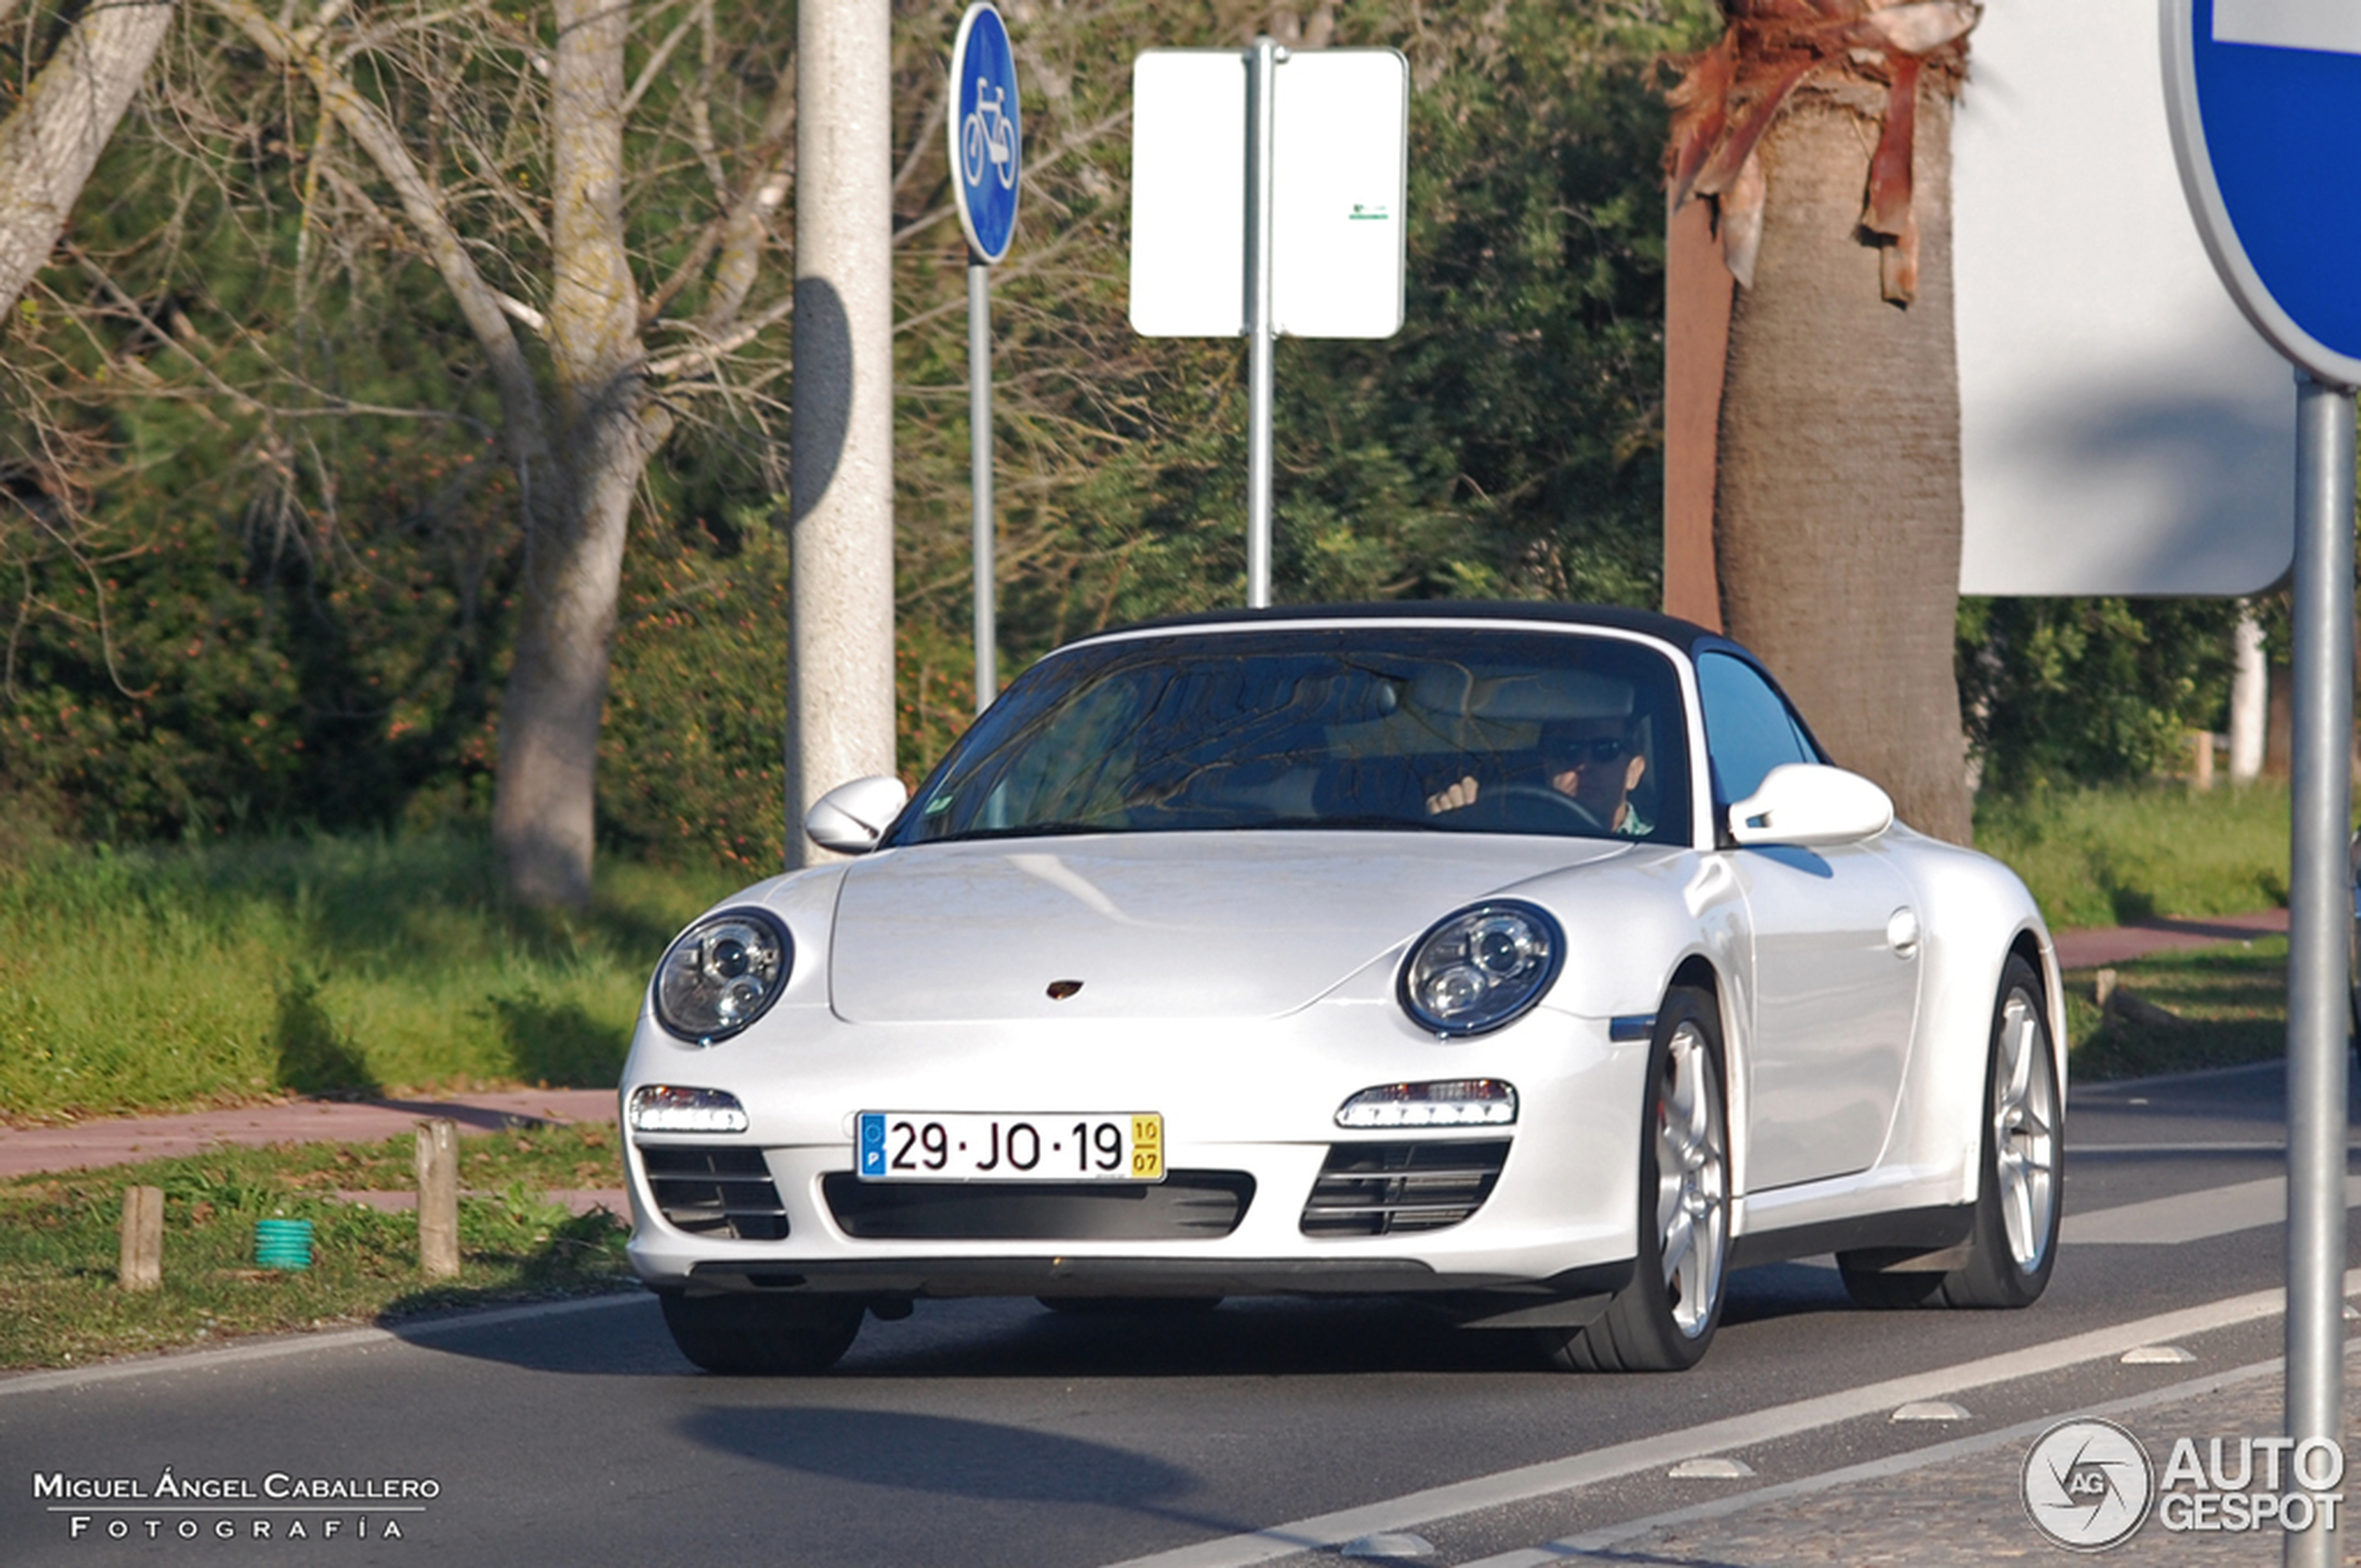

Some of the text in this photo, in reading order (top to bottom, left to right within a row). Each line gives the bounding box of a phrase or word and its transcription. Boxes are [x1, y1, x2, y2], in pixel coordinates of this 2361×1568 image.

[1136, 1122, 1157, 1140] 10
[867, 1152, 879, 1166] P
[1133, 1153, 1157, 1171] 07
